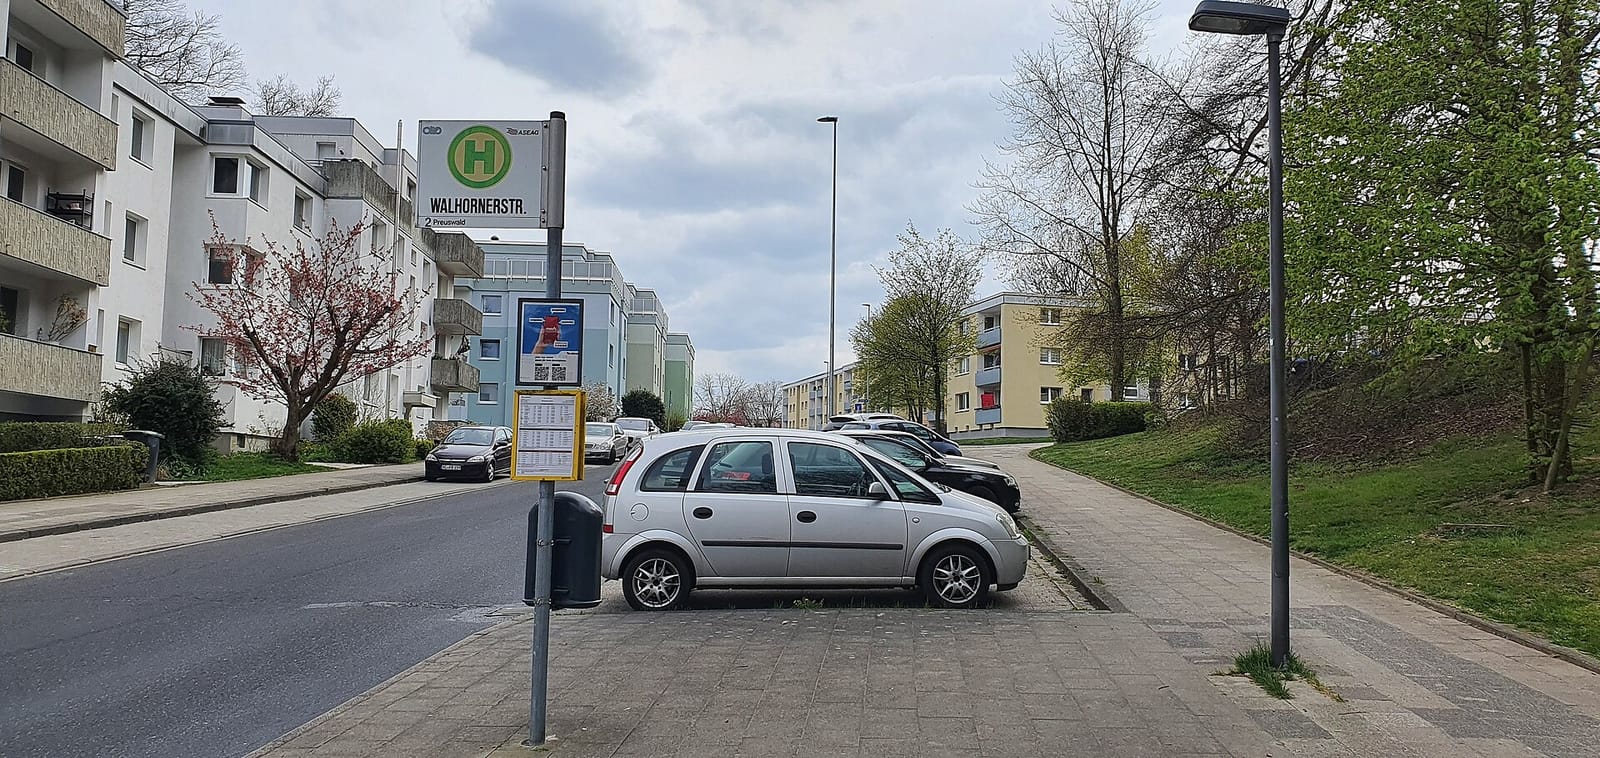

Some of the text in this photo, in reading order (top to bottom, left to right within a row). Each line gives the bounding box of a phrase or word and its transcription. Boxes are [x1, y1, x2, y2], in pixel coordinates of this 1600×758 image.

[464, 140, 496, 174] H
[430, 198, 527, 215] WALHORNERSTR.
[425, 218, 466, 227] 2 Preuswald
